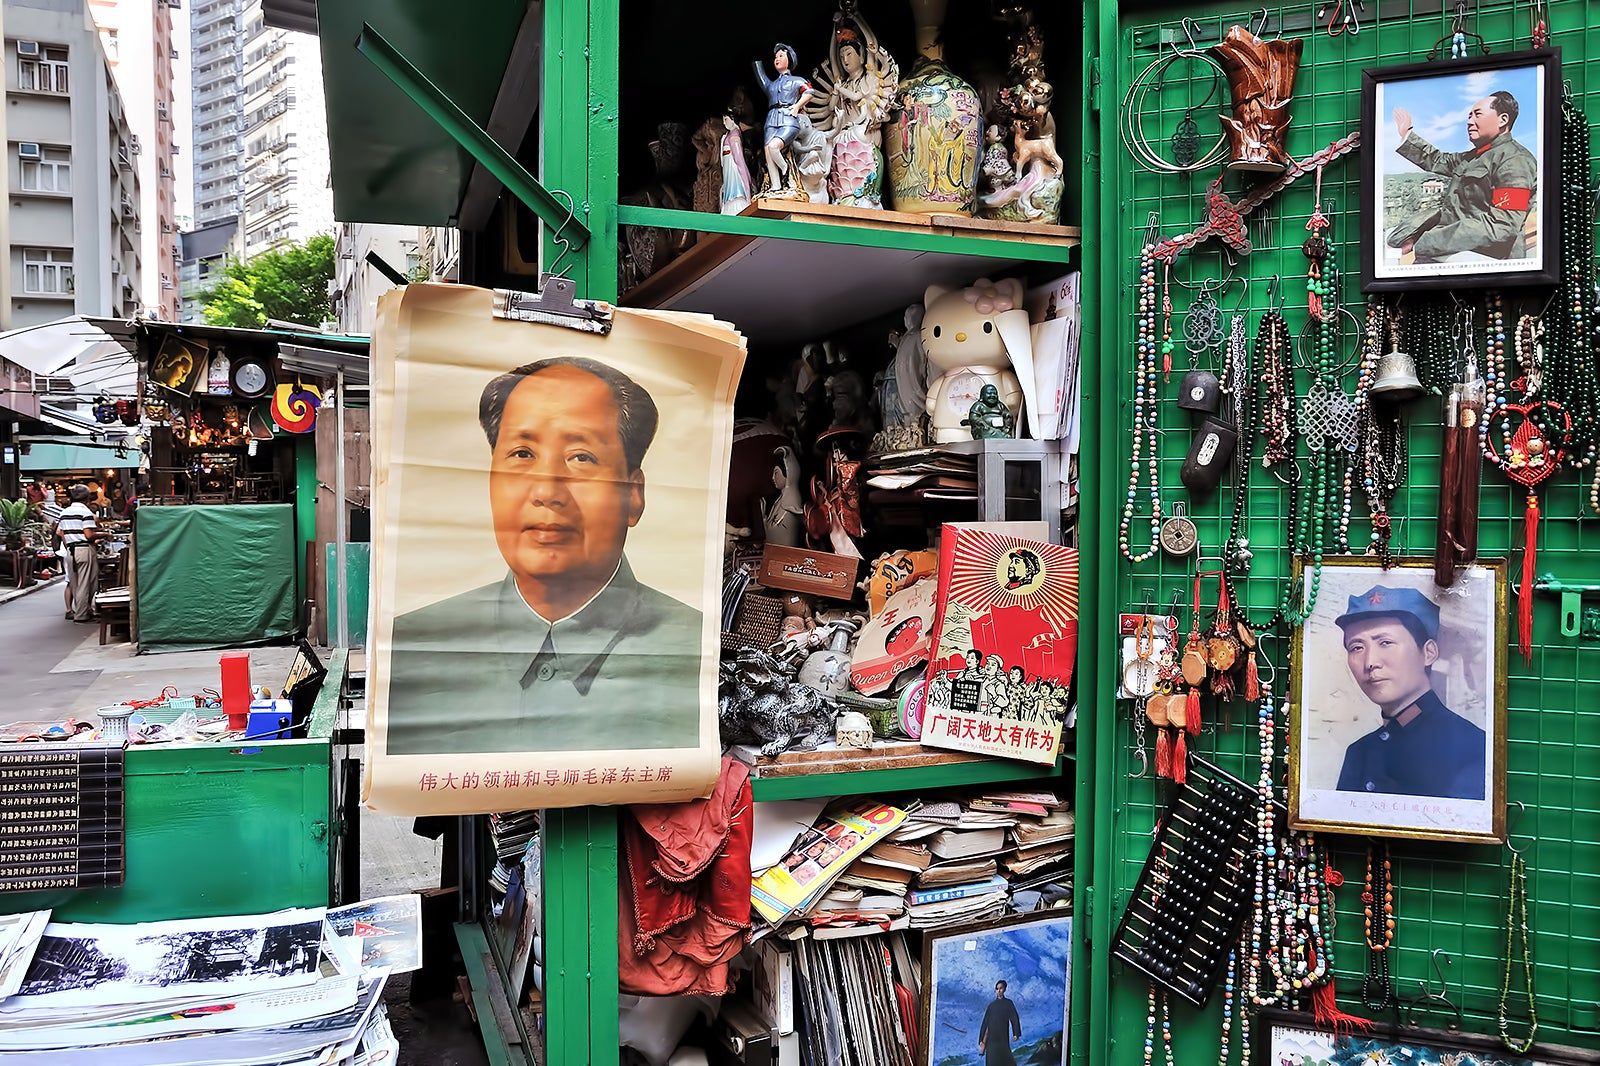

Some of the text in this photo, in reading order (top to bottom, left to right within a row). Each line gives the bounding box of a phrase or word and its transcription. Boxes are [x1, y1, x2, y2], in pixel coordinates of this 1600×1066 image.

[930, 713, 1054, 752] 广阔天地大有作为
[418, 766, 673, 791] 伟大的领袖和导师毛泽东主席
